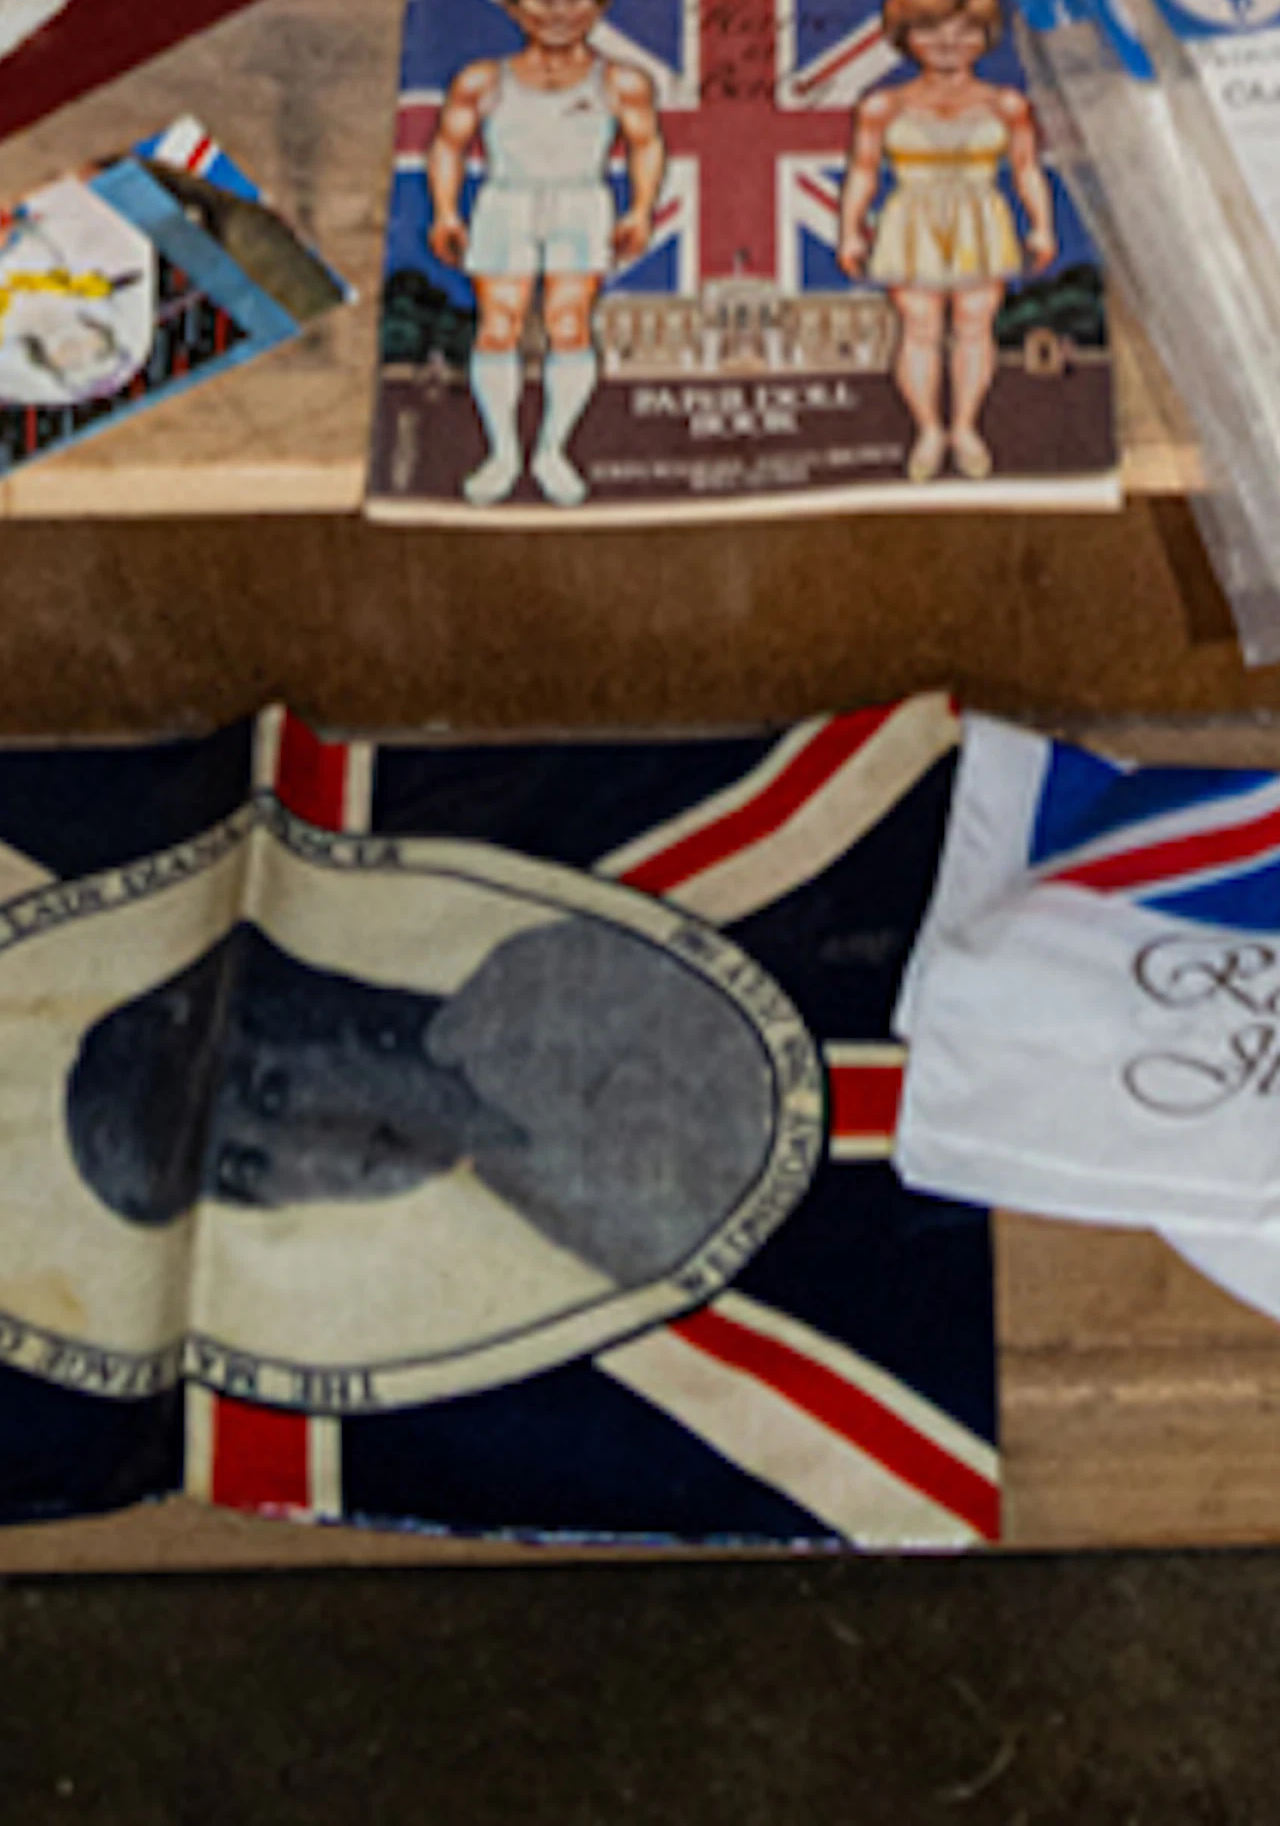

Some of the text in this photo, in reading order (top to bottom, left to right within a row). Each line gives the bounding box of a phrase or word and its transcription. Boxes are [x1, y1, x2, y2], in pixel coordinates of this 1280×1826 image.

[632, 380, 859, 417] PAPER DOLL
[292, 1369, 380, 1407] THE
